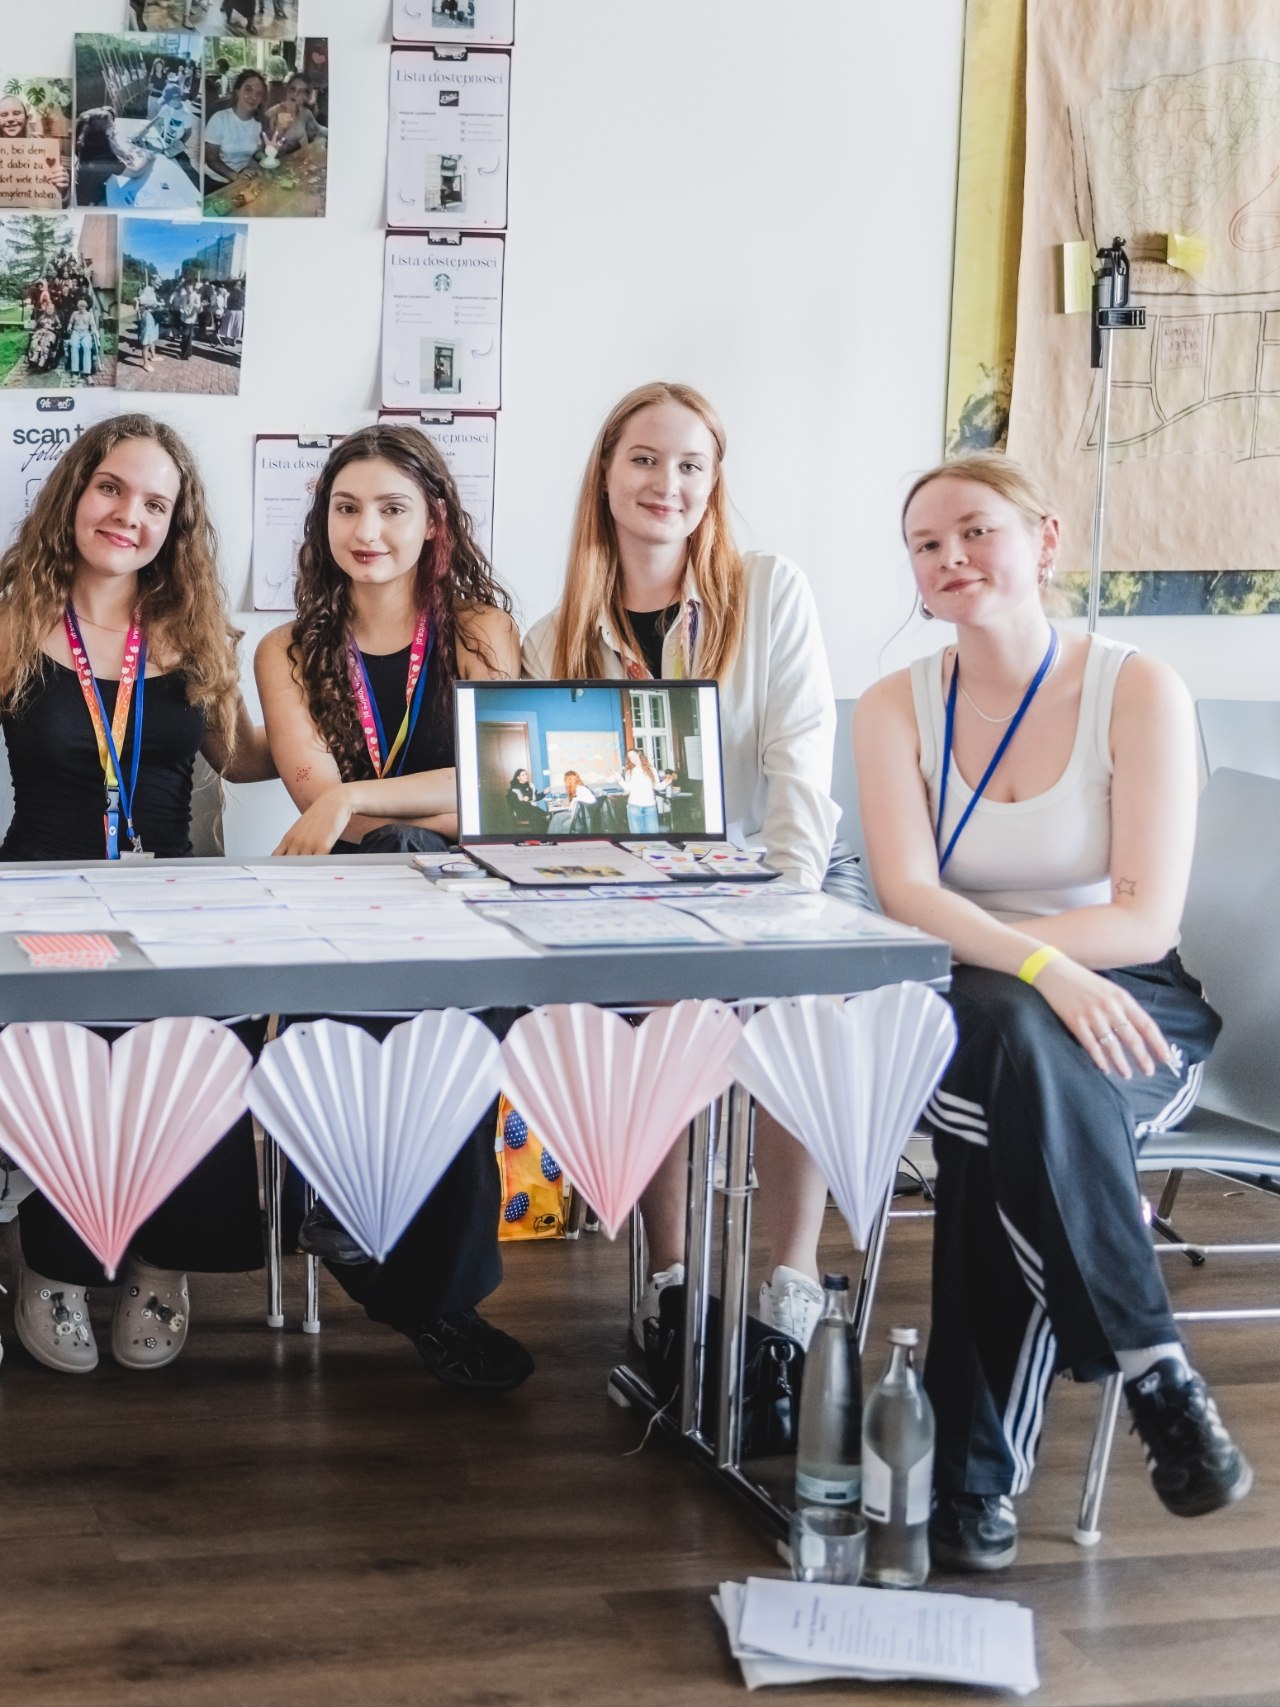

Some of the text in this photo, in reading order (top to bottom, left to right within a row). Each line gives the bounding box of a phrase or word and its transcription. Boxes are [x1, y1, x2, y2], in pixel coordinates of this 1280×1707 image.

[396, 69, 426, 83] Lista
[11, 144, 25, 155] bei
[27, 144, 46, 156] dem
[7, 159, 30, 170] dabei
[33, 161, 44, 170] zu
[15, 175, 32, 184] viele
[391, 254, 420, 266] Lista
[13, 423, 84, 444] scan t
[20, 439, 64, 473] follo
[261, 456, 290, 470] Lista
